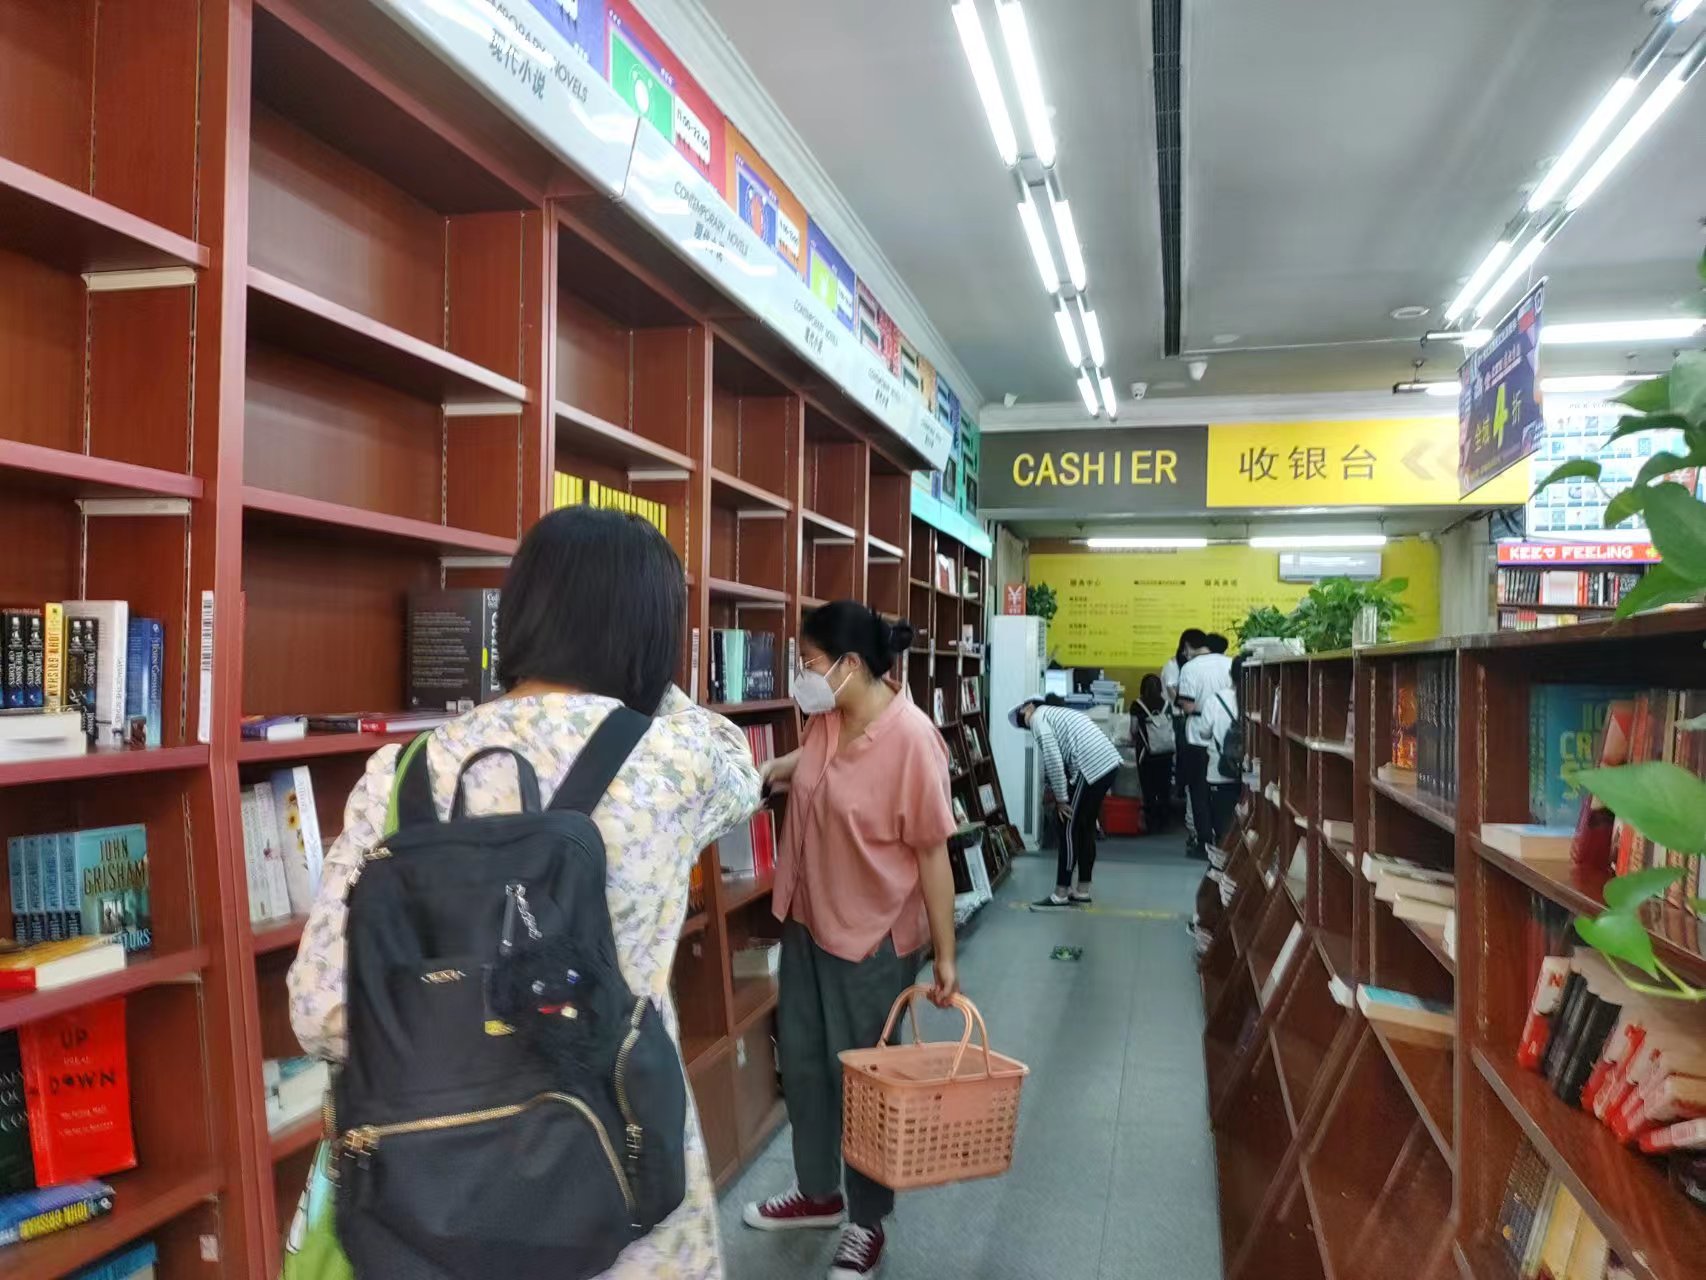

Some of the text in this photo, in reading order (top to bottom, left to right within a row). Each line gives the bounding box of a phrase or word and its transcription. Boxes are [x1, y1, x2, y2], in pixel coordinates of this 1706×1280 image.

[489, 27, 546, 101] 现代小说
[553, 57, 588, 104] NOVELS
[1012, 449, 1178, 487] CASHIER
[1239, 445, 1378, 482] 收银台
[1562, 546, 1633, 560] FEELING
[34, 665, 43, 685] KING
[46, 632, 59, 697] JOHN GRISHAM
[99, 834, 129, 862] JOHN
[83, 859, 147, 897] GRISHAM
[61, 1028, 89, 1050] UP
[48, 1068, 116, 1097] DOWN
